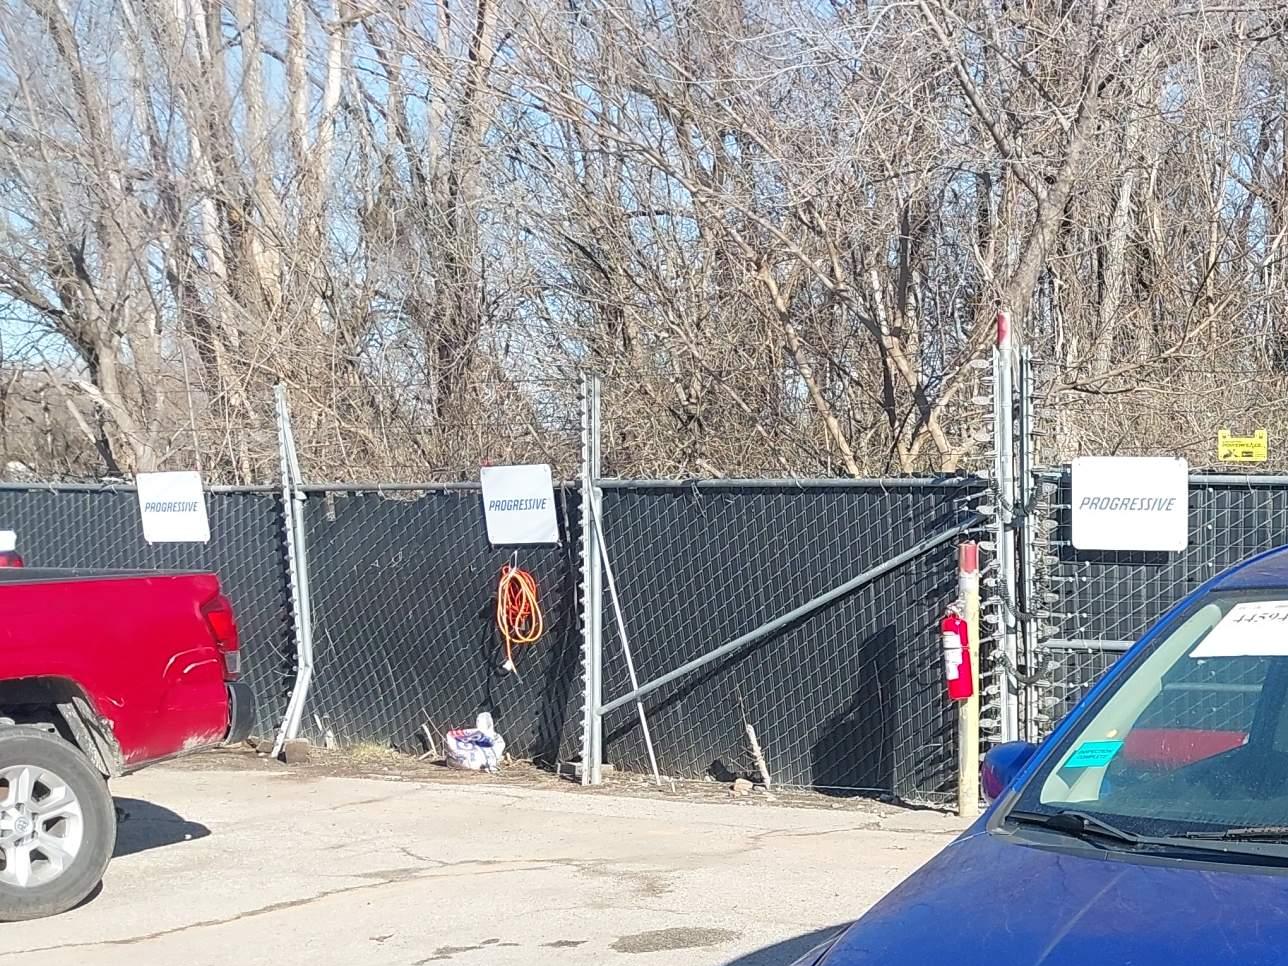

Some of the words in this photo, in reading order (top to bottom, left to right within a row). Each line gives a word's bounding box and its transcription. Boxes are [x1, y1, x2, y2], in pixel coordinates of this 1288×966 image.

[144, 502, 198, 512] PROGRESSIVE
[489, 498, 547, 511] PROGRESSIVE
[1080, 497, 1176, 511] PROGRESSIVE
